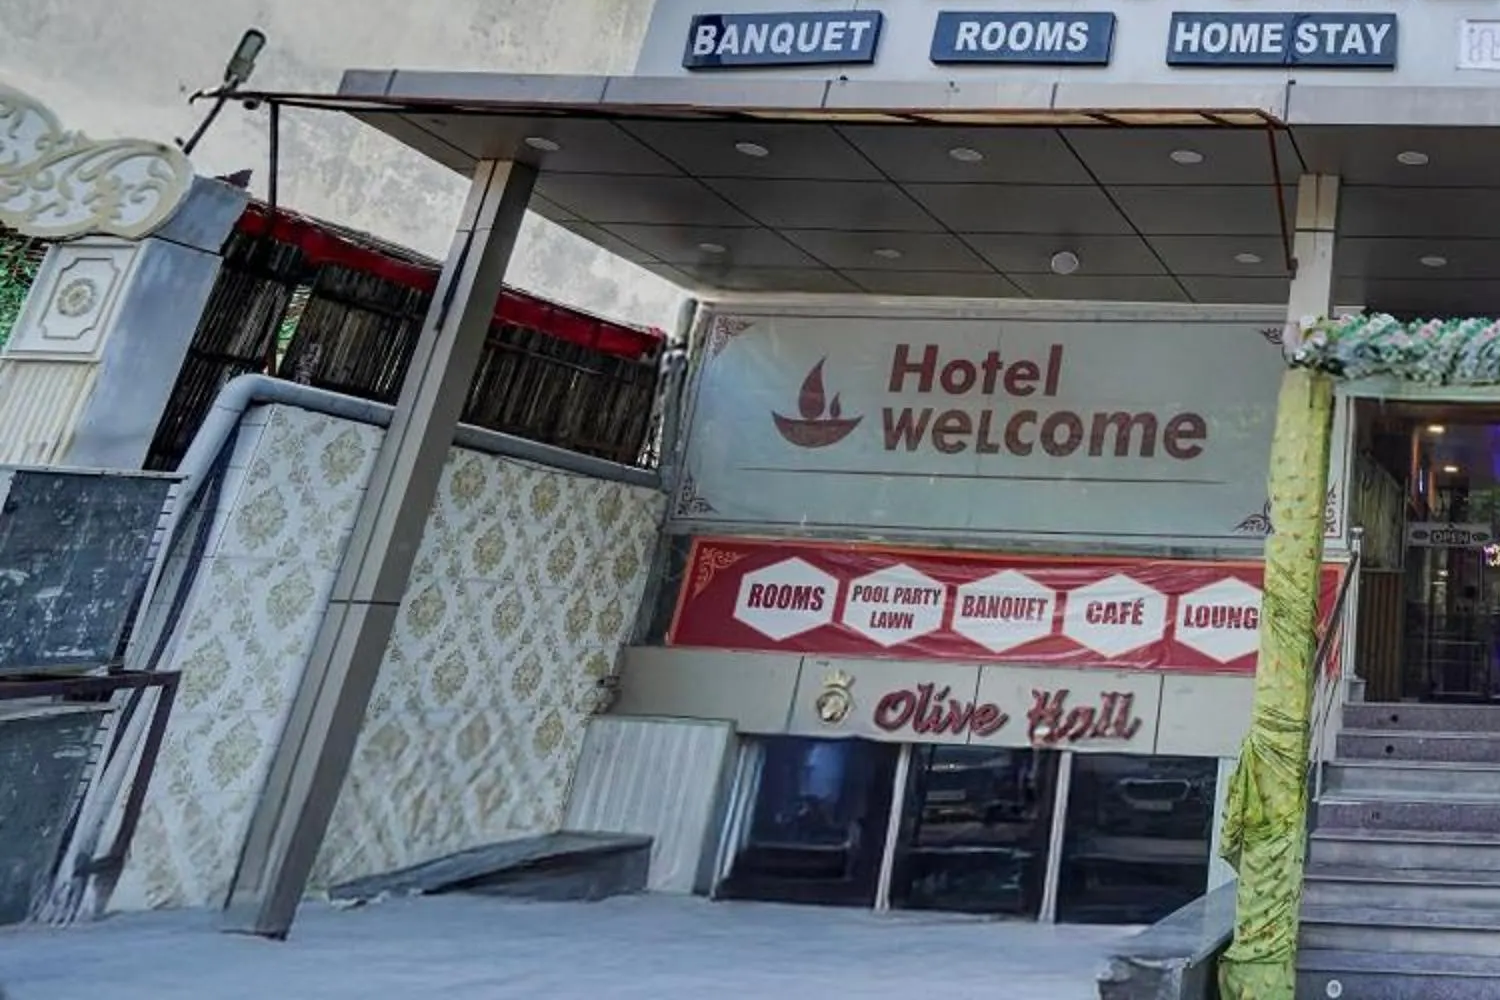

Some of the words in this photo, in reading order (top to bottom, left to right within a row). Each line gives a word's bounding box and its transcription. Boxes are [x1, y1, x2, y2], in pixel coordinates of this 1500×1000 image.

[692, 20, 872, 56] BANQUET
[954, 21, 1090, 53] ROOMS
[1174, 22, 1284, 54] HOME
[1295, 22, 1391, 55] STAY
[888, 344, 1063, 397] Hotel
[747, 583, 825, 611] ROOMS
[852, 585, 890, 604] POOL
[893, 586, 942, 607] PARTY
[961, 594, 1049, 622] BANQUET
[870, 611, 914, 630] LAWN
[1085, 598, 1145, 626] CAFÉ
[1184, 603, 1260, 630] LOUNG
[873, 683, 1009, 737] Olive
[1027, 689, 1142, 746] Hall
